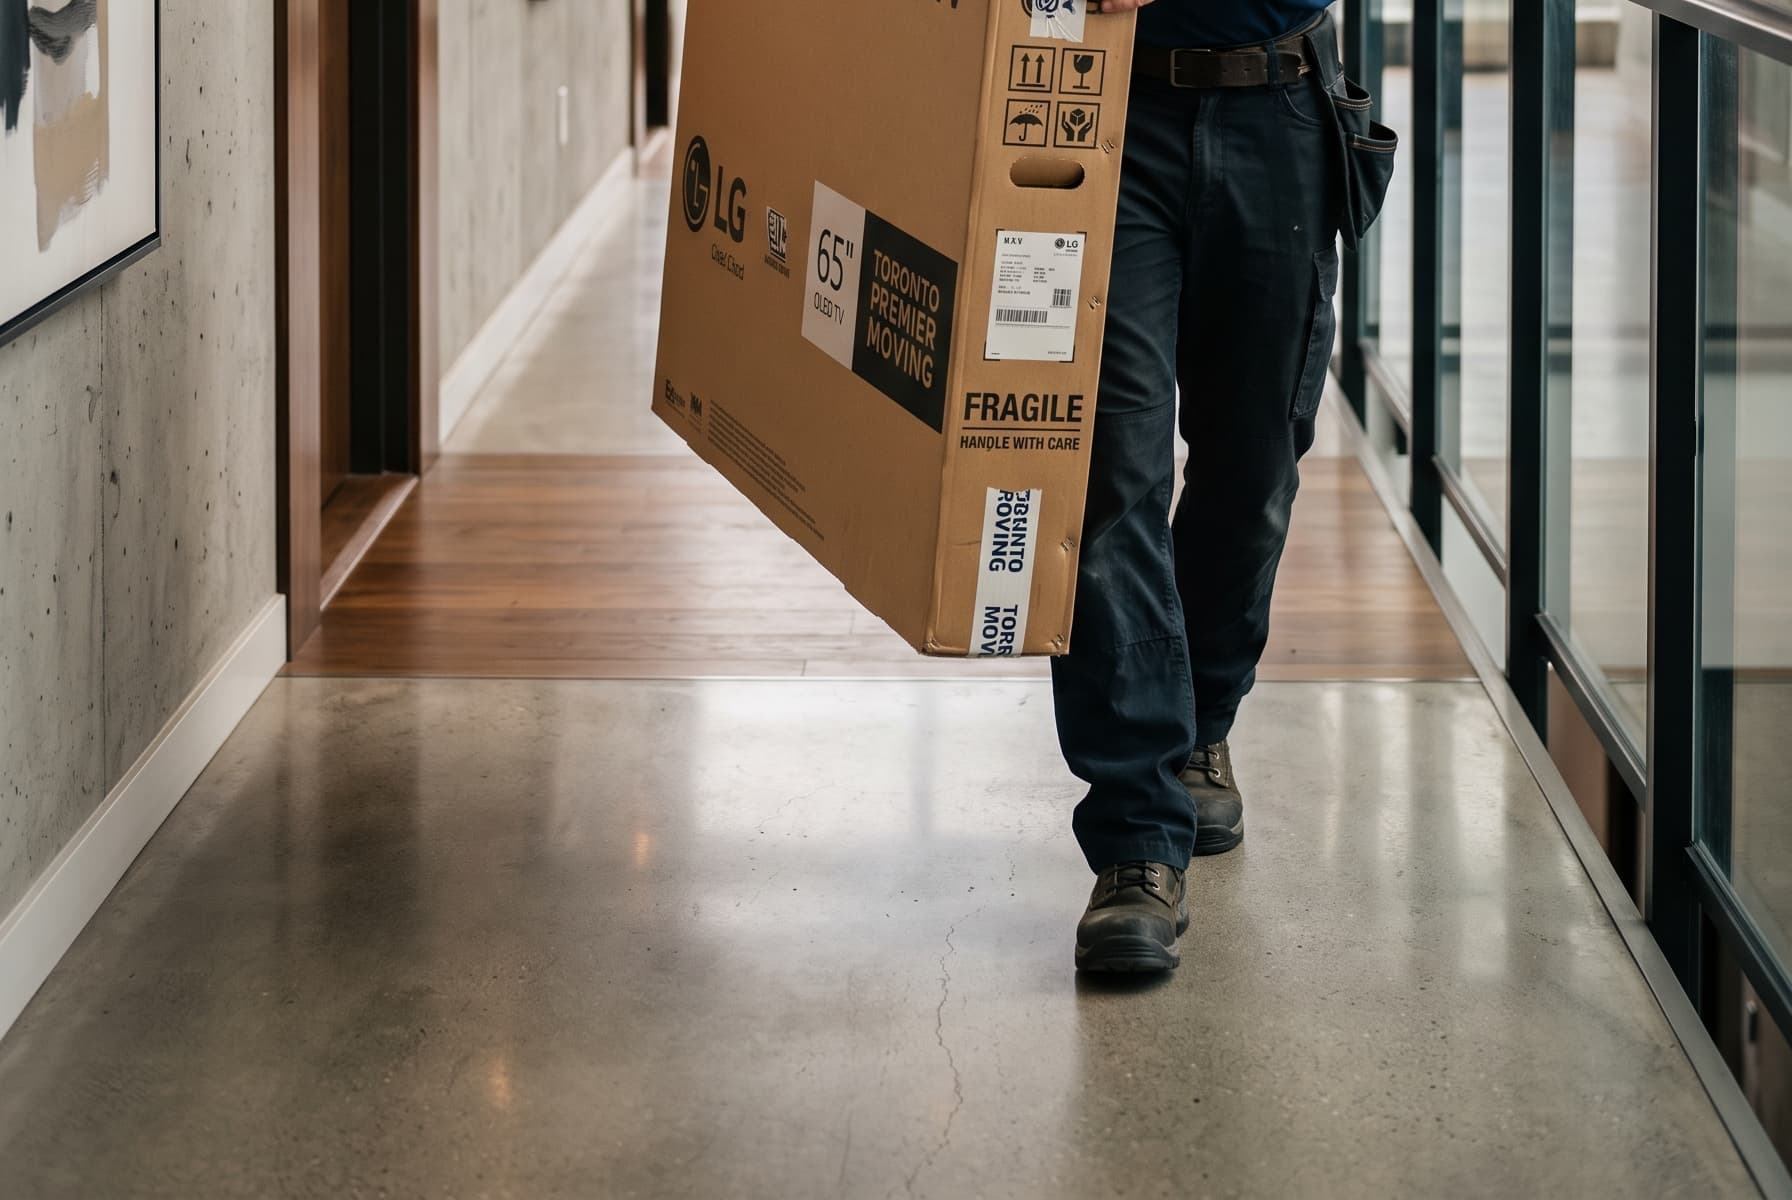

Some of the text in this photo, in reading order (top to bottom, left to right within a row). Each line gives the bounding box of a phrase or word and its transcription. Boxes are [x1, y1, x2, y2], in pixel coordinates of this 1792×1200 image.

[714, 164, 747, 243] LG
[817, 228, 854, 292] 65"
[1066, 240, 1079, 249] LG
[814, 291, 845, 326] OLED TV
[873, 249, 940, 313] TORONTO
[870, 281, 936, 351] PREMIER
[866, 316, 934, 389] MOVING
[964, 392, 1084, 423] FRAGILE
[960, 435, 1080, 451] HANDLE WITH CARE
